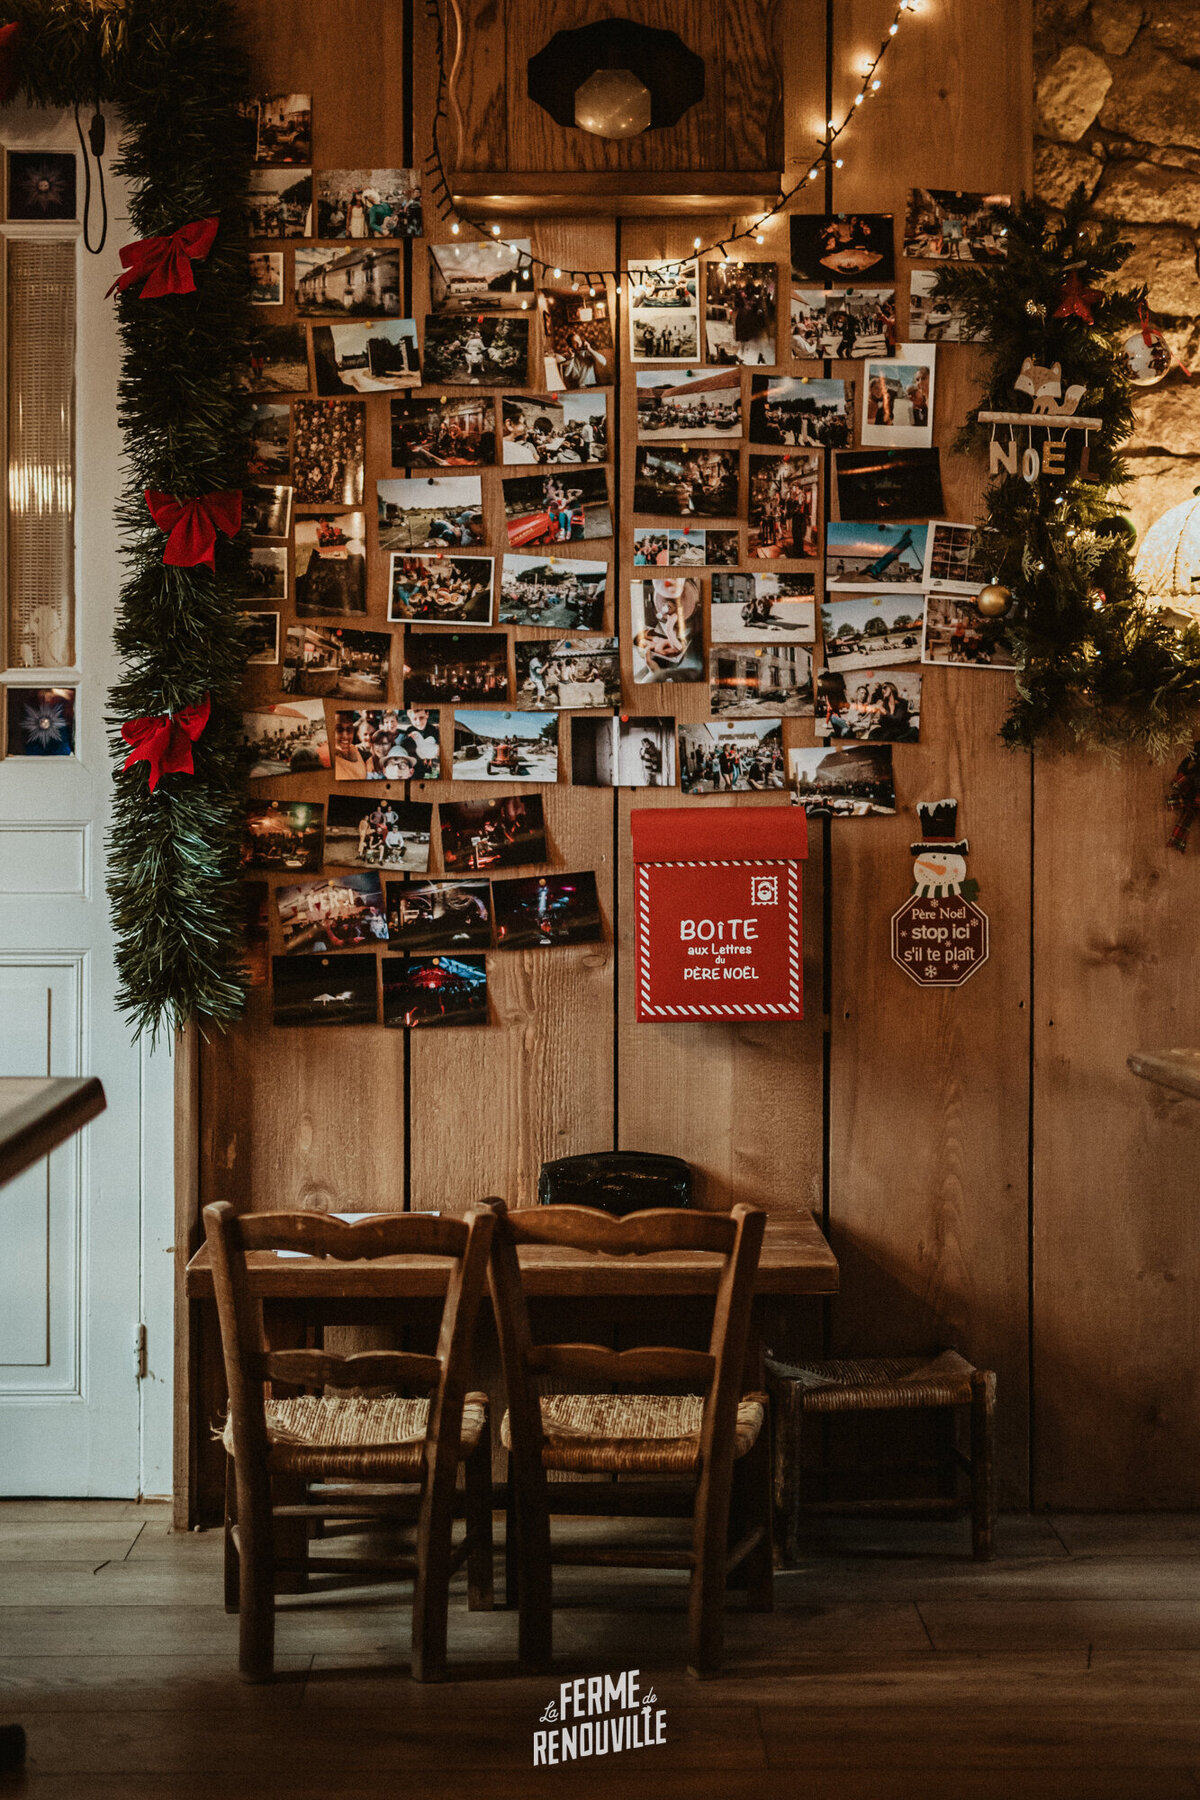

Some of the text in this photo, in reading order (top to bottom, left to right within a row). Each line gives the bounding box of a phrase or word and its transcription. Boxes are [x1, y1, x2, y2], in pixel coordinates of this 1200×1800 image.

[990, 441, 1100, 483] NOEL
[912, 906, 966, 920] Père Noël
[911, 923, 970, 943] stop ici
[687, 943, 752, 956] aux Lettres
[904, 946, 976, 964] s'il te plaît
[715, 955, 726, 965] du
[684, 965, 760, 980] PÈRE NOËL
